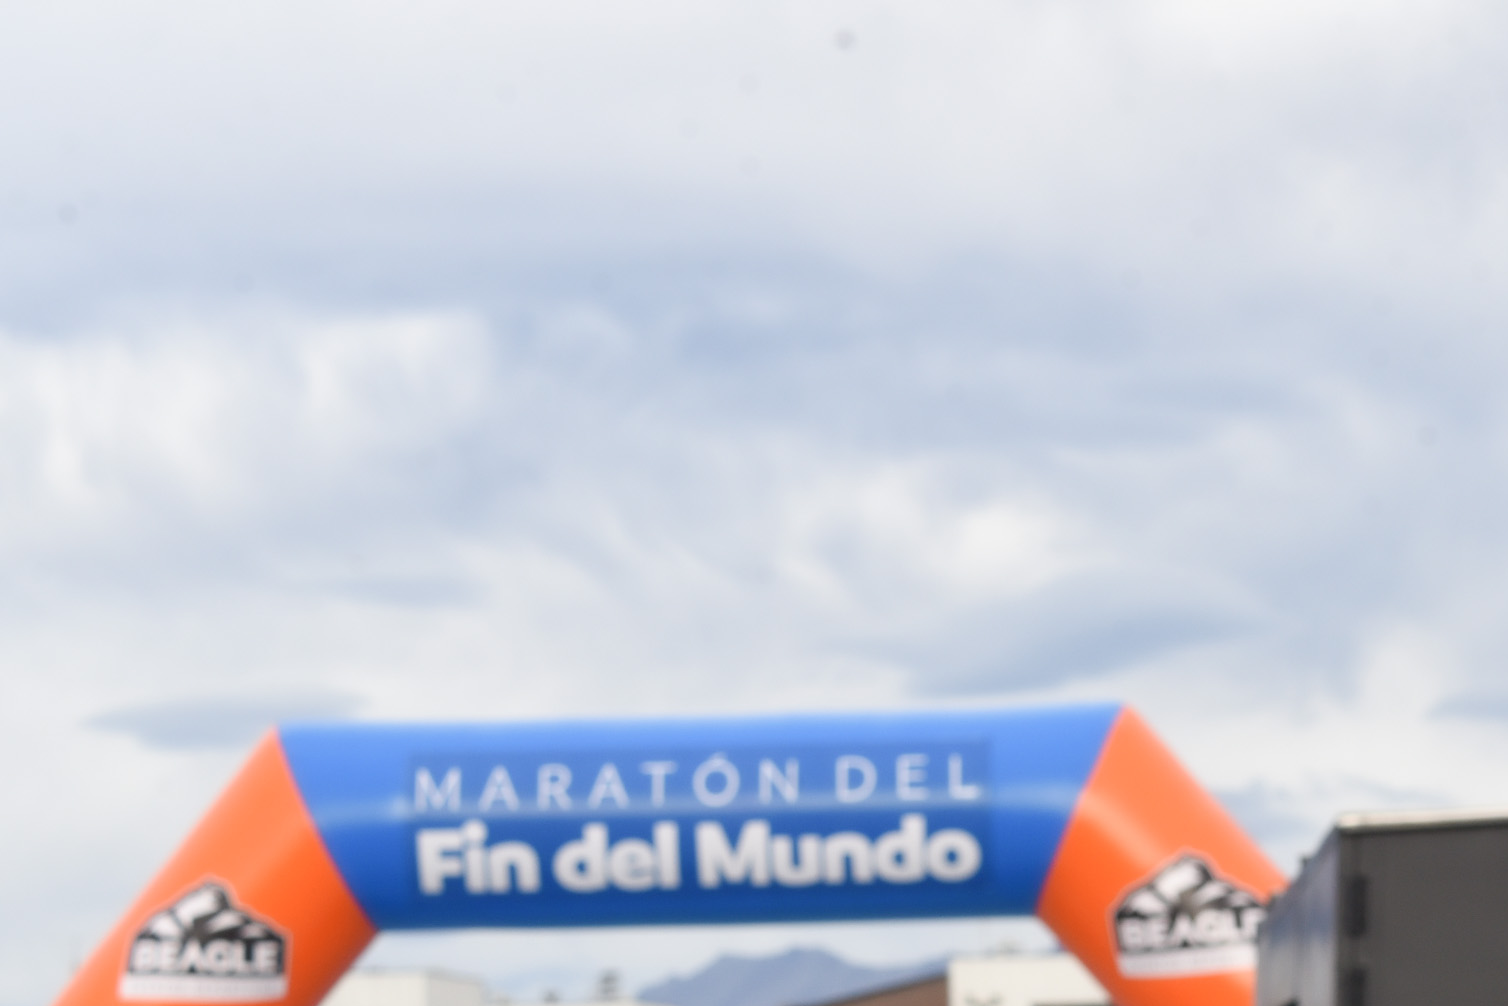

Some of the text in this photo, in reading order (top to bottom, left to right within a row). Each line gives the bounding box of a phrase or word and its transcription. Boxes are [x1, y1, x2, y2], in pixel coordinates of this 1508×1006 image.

[414, 752, 982, 813] MARATÓN DEL
[415, 813, 983, 895] Fin del Mundo
[131, 937, 280, 975] BEAGLE
